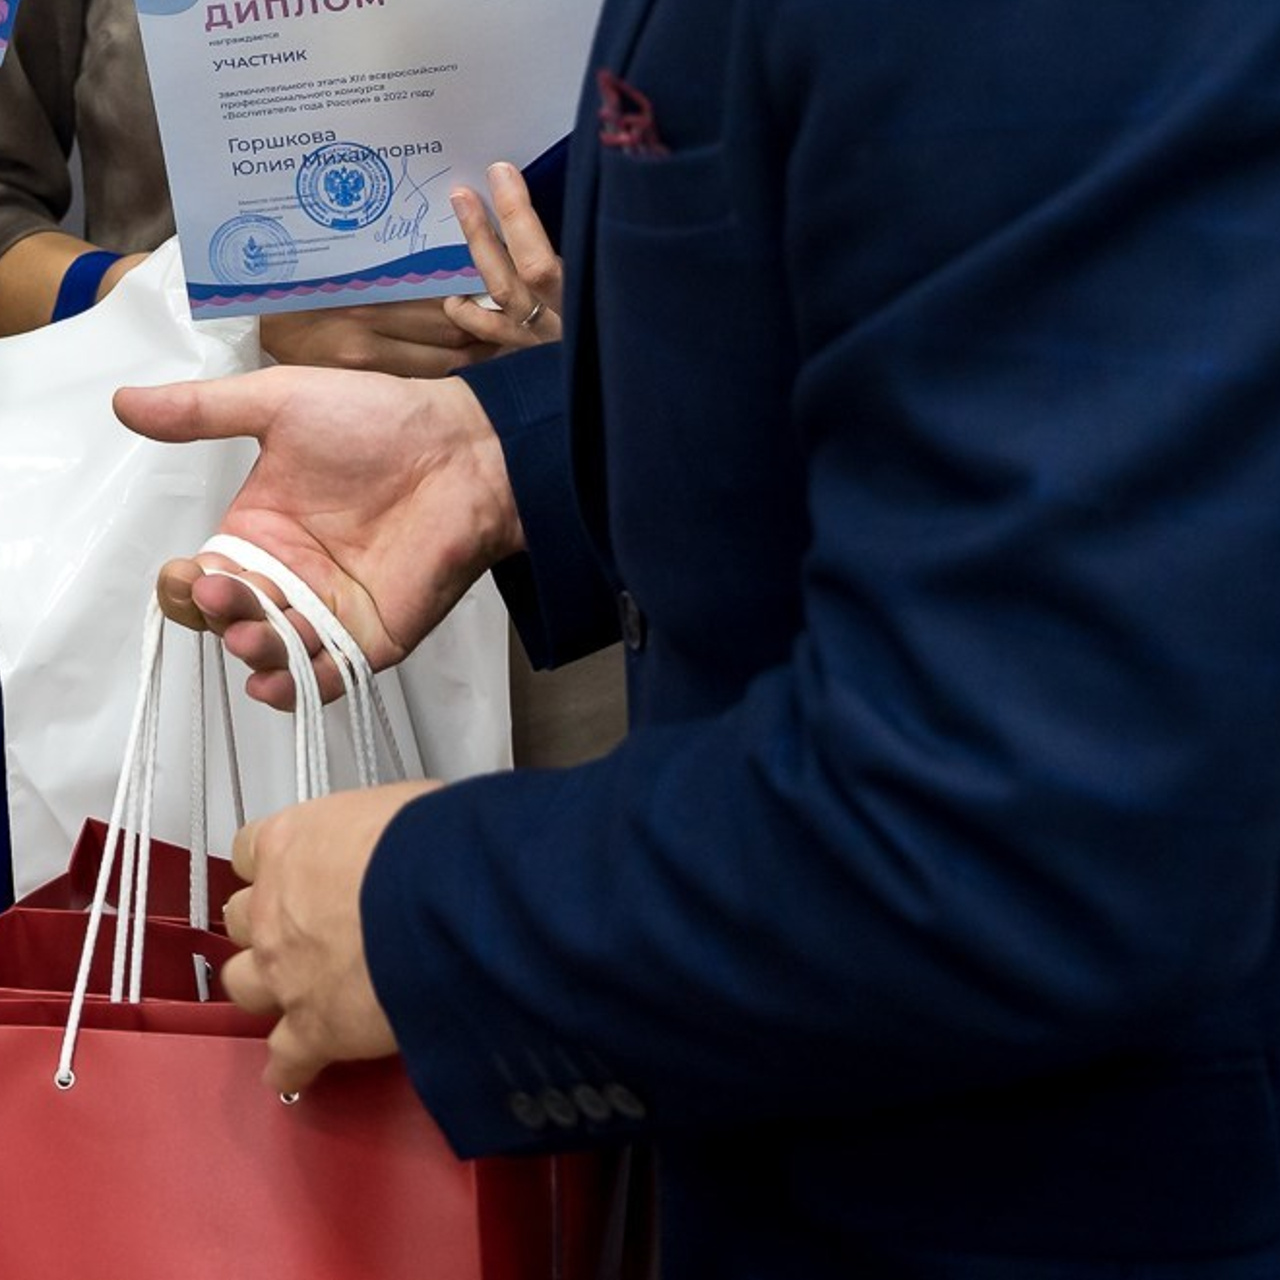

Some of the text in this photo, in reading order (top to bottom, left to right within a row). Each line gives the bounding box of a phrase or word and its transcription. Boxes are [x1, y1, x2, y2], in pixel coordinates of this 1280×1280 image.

[213, 49, 308, 72] УЧАСТНИК
[382, 90, 408, 101] 2022
[228, 129, 336, 154] Горшкова
[232, 140, 443, 176] Юлия Михайловна
